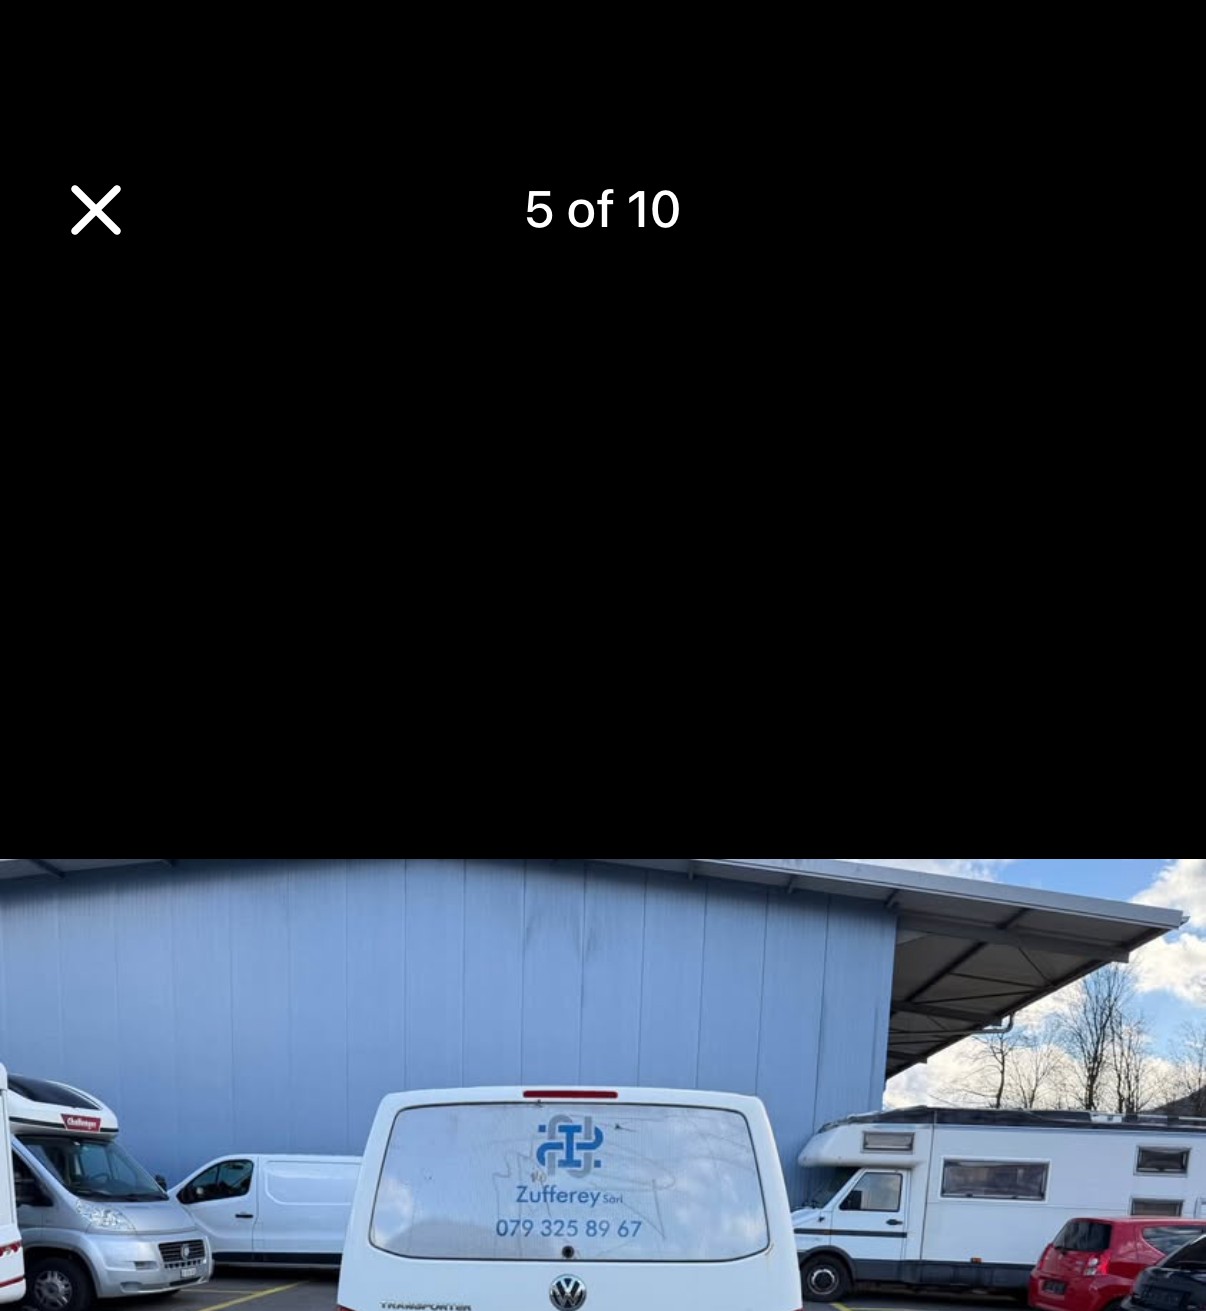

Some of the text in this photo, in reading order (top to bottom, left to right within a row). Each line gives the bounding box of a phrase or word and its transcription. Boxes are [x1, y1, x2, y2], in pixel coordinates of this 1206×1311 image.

[516, 1184, 600, 1208] Zufferey
[496, 1219, 642, 1238] 079 325 89 67
